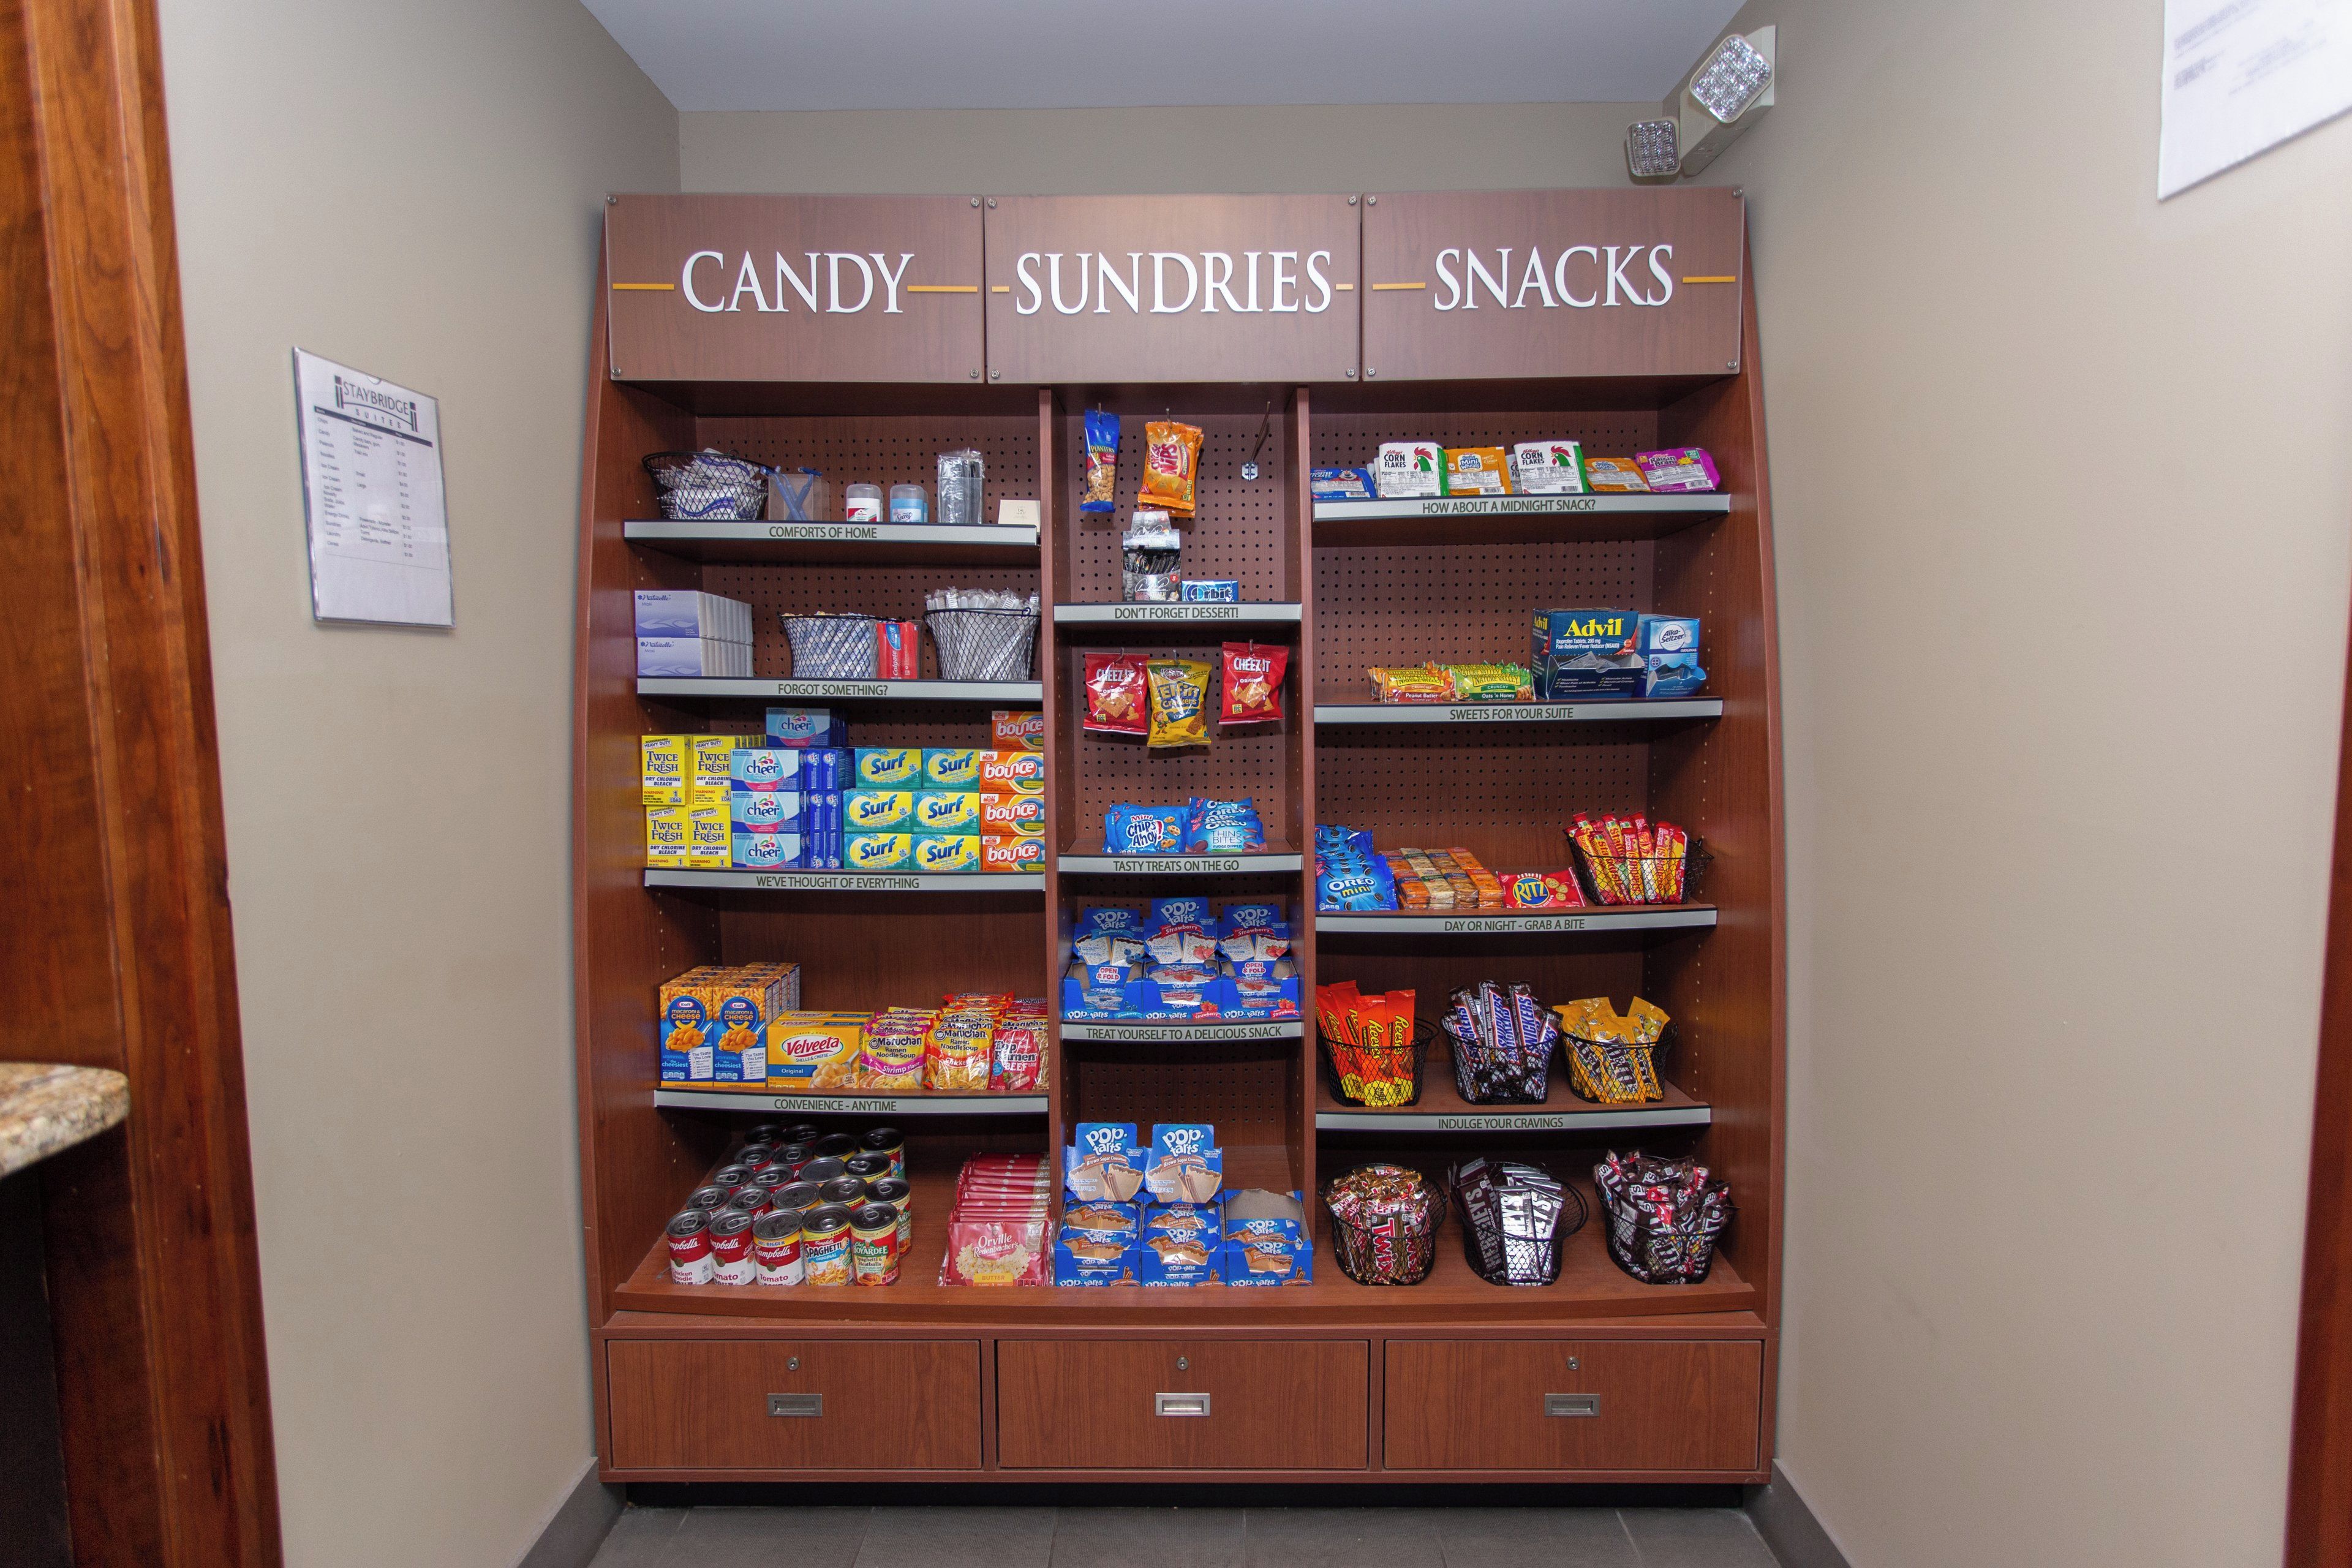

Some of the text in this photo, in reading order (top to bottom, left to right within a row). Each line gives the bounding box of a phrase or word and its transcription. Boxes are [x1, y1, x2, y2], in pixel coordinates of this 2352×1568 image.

[682, 251, 915, 314] CANDY
[1016, 250, 1332, 315] SUNDRIES
[1434, 244, 1673, 312] SNACKS
[343, 382, 409, 415] STAYBRIDGE
[355, 409, 401, 429] SUITES
[1423, 499, 1596, 513] HOW ABOUT A MIDNIGHT SNACK?
[769, 527, 876, 538] COMFORTS OF HOME
[1115, 607, 1238, 619] DON'T FORGET DESSERT!
[1534, 616, 1548, 630] Advil
[1563, 618, 1623, 636] Advil
[1661, 634, 1684, 643] Seltzer
[778, 684, 888, 695] FORGOT SOMETHING?
[1450, 707, 1573, 720] SWEETS FOR YOUR SUITE
[781, 717, 811, 731] cheer
[997, 720, 1043, 736] bounce
[646, 751, 678, 761] TWICE
[698, 751, 729, 761] TWICE
[647, 761, 678, 774] FRESH
[698, 761, 730, 774] FRESH
[747, 760, 778, 775] cheer
[871, 751, 907, 775] Surf
[938, 751, 974, 775] Surf
[985, 761, 1035, 778] bounce
[747, 802, 779, 816] cheer
[859, 794, 897, 818] Surf
[928, 794, 965, 819] Surf
[986, 804, 1036, 820] bounce
[651, 820, 682, 830] TWICE
[1128, 821, 1156, 837] Chips
[652, 830, 682, 842] FRESH
[988, 845, 1037, 861] bounce
[1114, 860, 1239, 872] TASTY TREATS ON THE GO
[756, 876, 919, 889] WE'VE THOUGHT OF EVERYTHING
[1328, 878, 1374, 891] OREO
[1341, 886, 1370, 897] mini
[1514, 882, 1547, 901] RITZ
[1169, 913, 1195, 925] tarts
[1241, 919, 1267, 928] tarts
[1444, 921, 1465, 931] DAY
[1467, 921, 1482, 931] OR
[1485, 920, 1517, 930] NIGHT
[1525, 919, 1551, 930] GRAB
[1554, 919, 1562, 929] A
[1564, 919, 1585, 929] BITE
[1166, 925, 1198, 935] Strawberry
[1238, 927, 1270, 937] Strawberry
[1086, 1026, 1282, 1040] TREAT YOURSELF TO A DELICIOUS SNACK
[786, 1036, 839, 1056] Velveeta
[878, 1036, 922, 1046] Maruchan
[908, 1061, 919, 1070] Flavor
[1005, 1063, 1028, 1071] BEEF
[774, 1099, 843, 1110] CONVENIENCE
[852, 1100, 896, 1112] ANYTIME
[1439, 1117, 1563, 1129] INDULGE YOUR CRAVINGS
[978, 1233, 1012, 1248] Orville
[755, 1246, 791, 1259] Campbell's
[973, 1241, 1019, 1258] Redenbacher's
